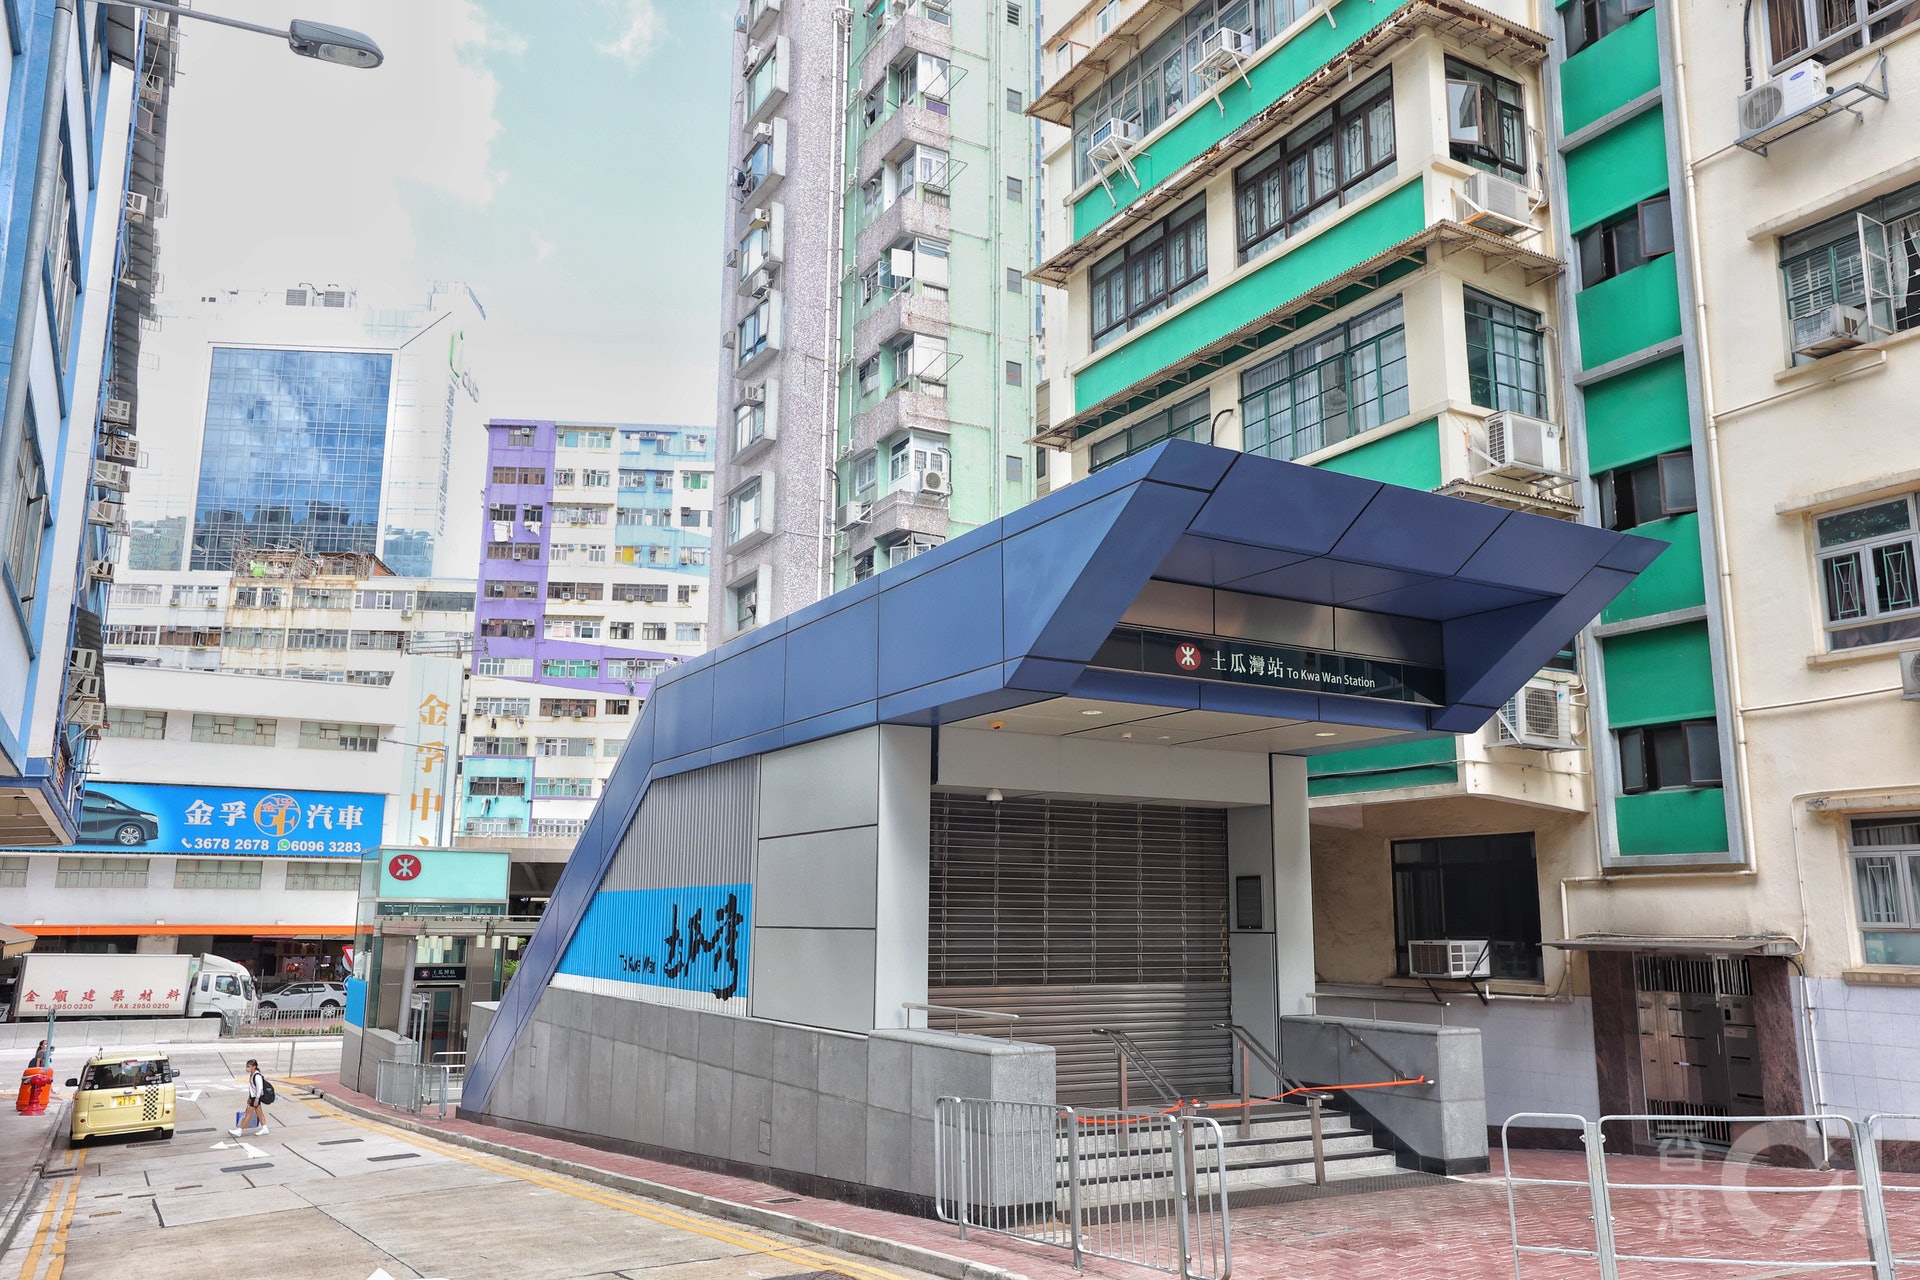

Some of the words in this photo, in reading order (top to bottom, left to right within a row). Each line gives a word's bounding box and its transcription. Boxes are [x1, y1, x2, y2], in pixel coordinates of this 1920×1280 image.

[1210, 650, 1285, 679] 土瓜灣站
[1287, 667, 1300, 679] To
[1300, 668, 1321, 682] Kwa
[1321, 671, 1343, 685] Wan
[1344, 674, 1376, 688] Station
[184, 799, 247, 827] 金孚
[306, 803, 365, 831] 汽車
[194, 837, 231, 851] 3678
[234, 838, 270, 851] 2678
[290, 840, 325, 853] 6096
[328, 841, 362, 853] 3283
[22, 988, 182, 1003] 金順建築材料
[152, 1002, 170, 1010] 0210
